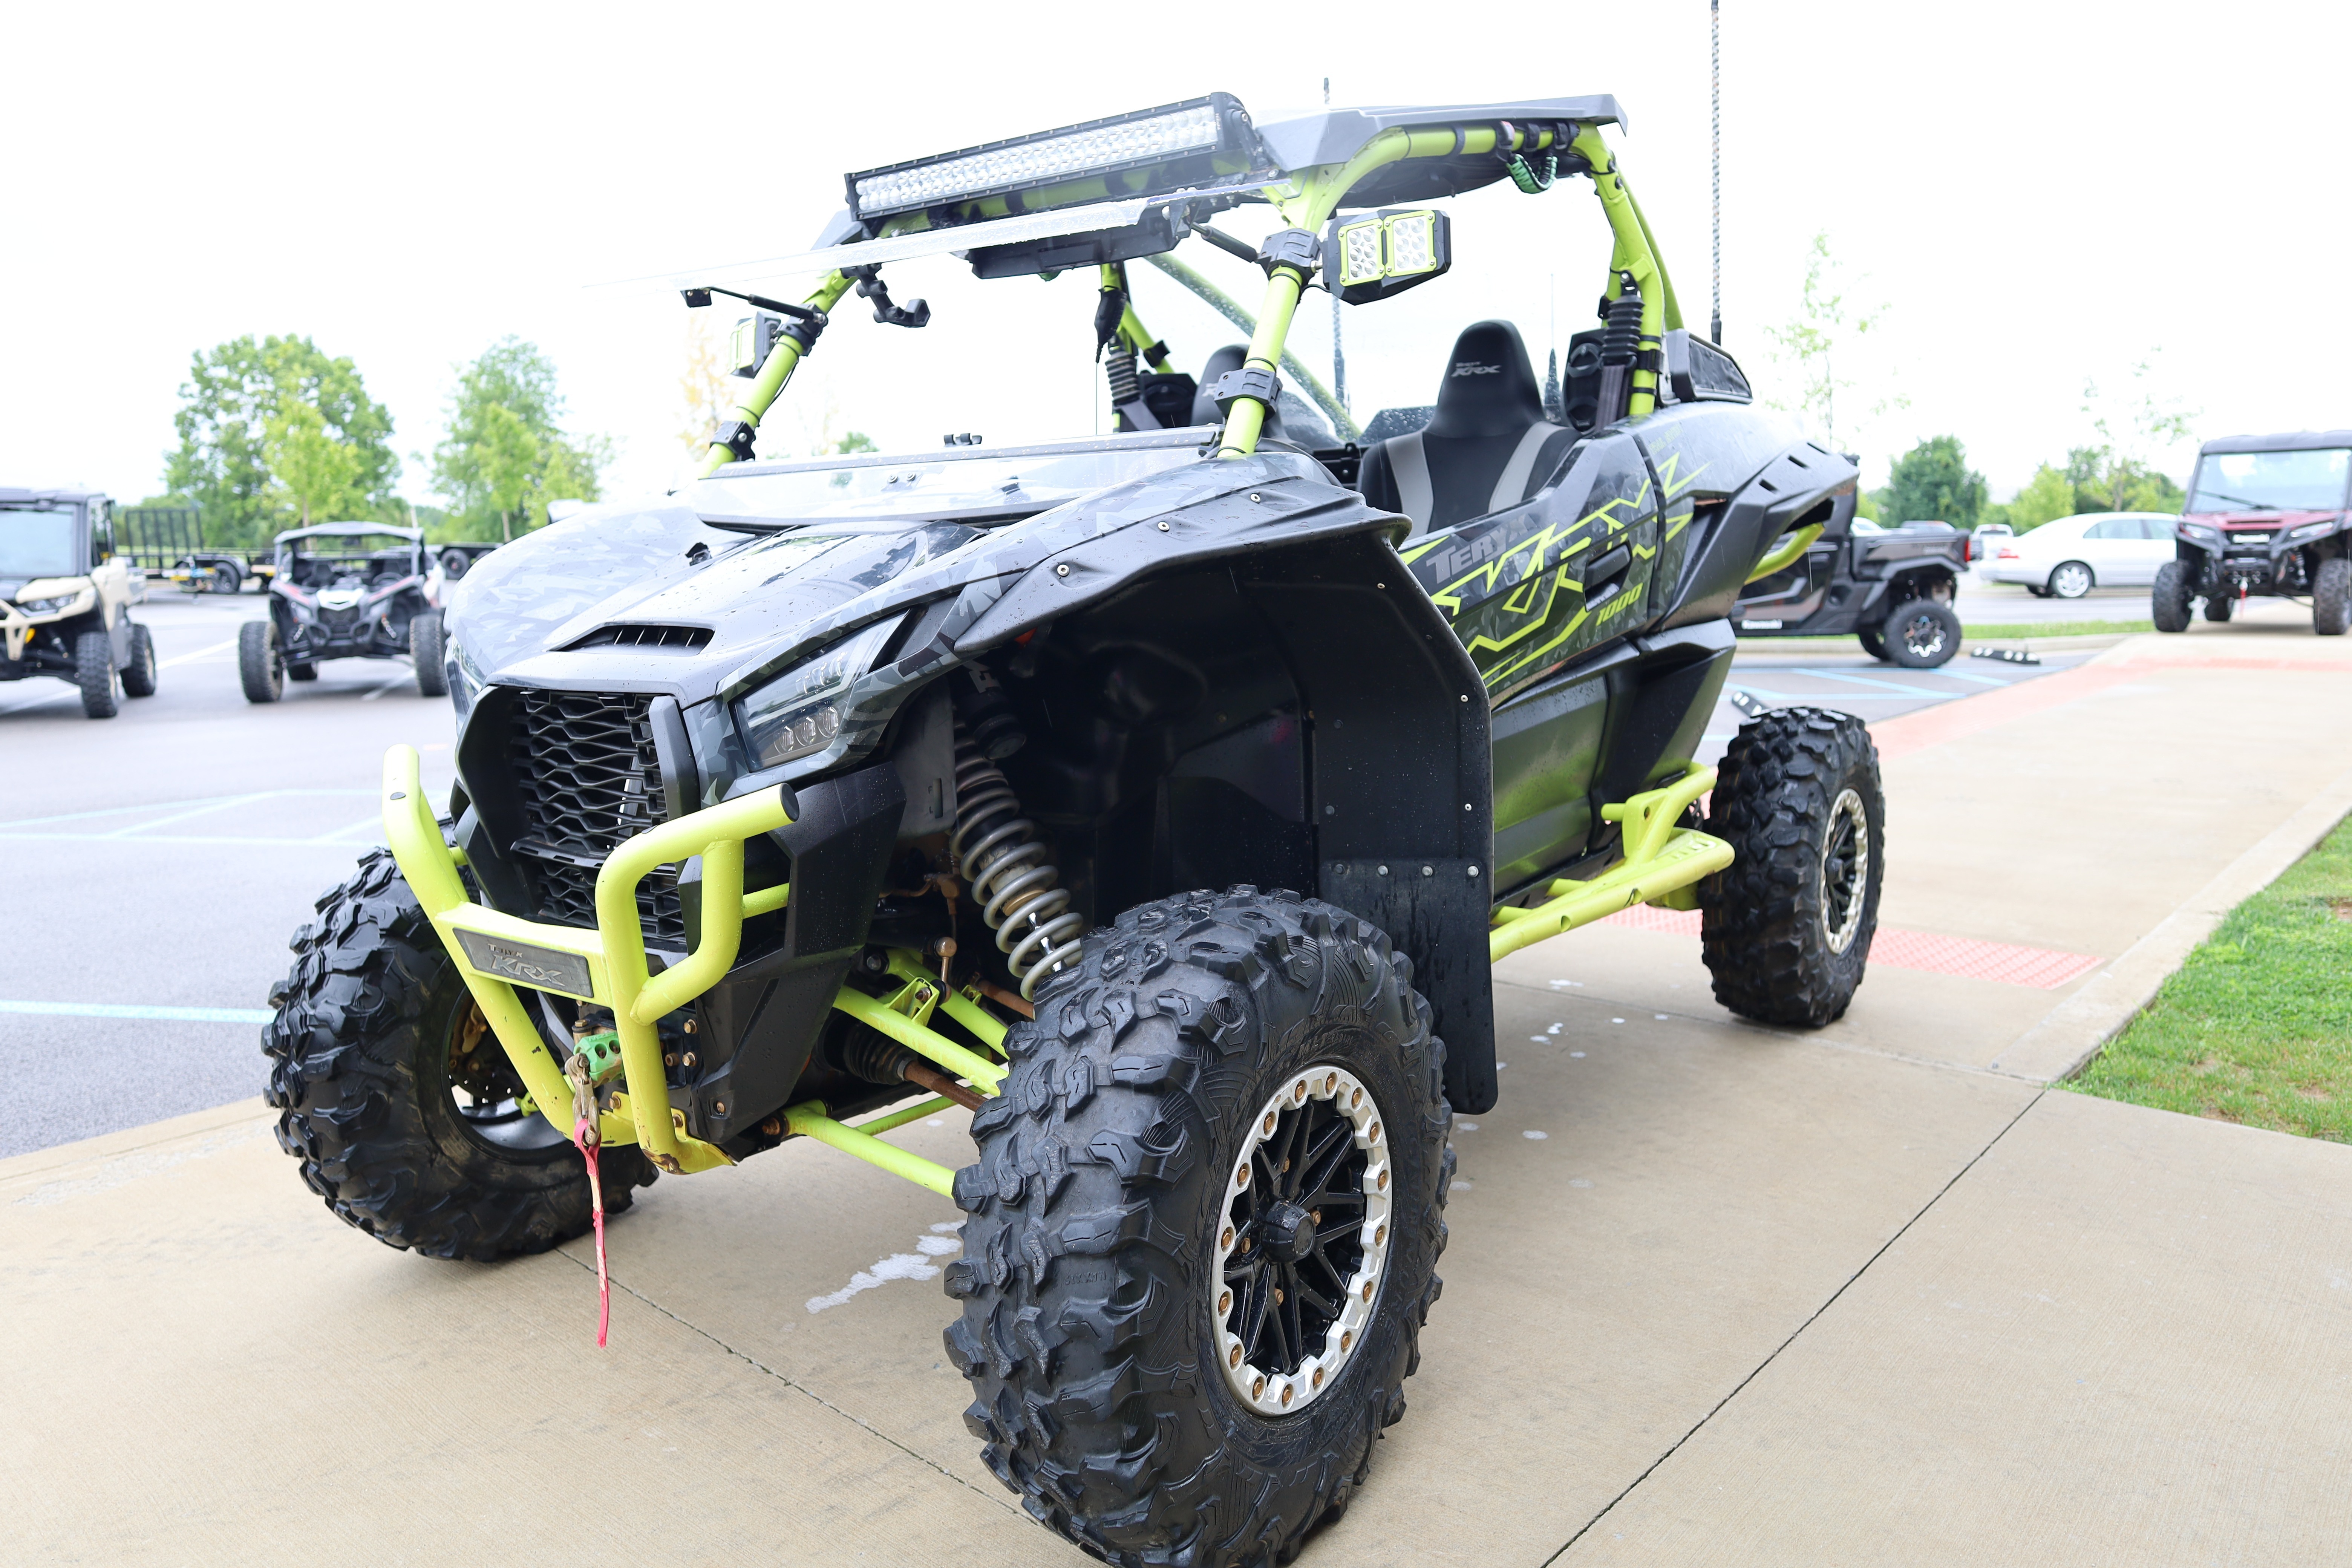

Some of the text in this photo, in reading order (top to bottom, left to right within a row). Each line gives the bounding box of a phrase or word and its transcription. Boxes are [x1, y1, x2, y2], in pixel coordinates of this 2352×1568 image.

[1451, 365, 1502, 377] KRX
[1596, 582, 1643, 626] 1000
[491, 954, 565, 986] KRX
